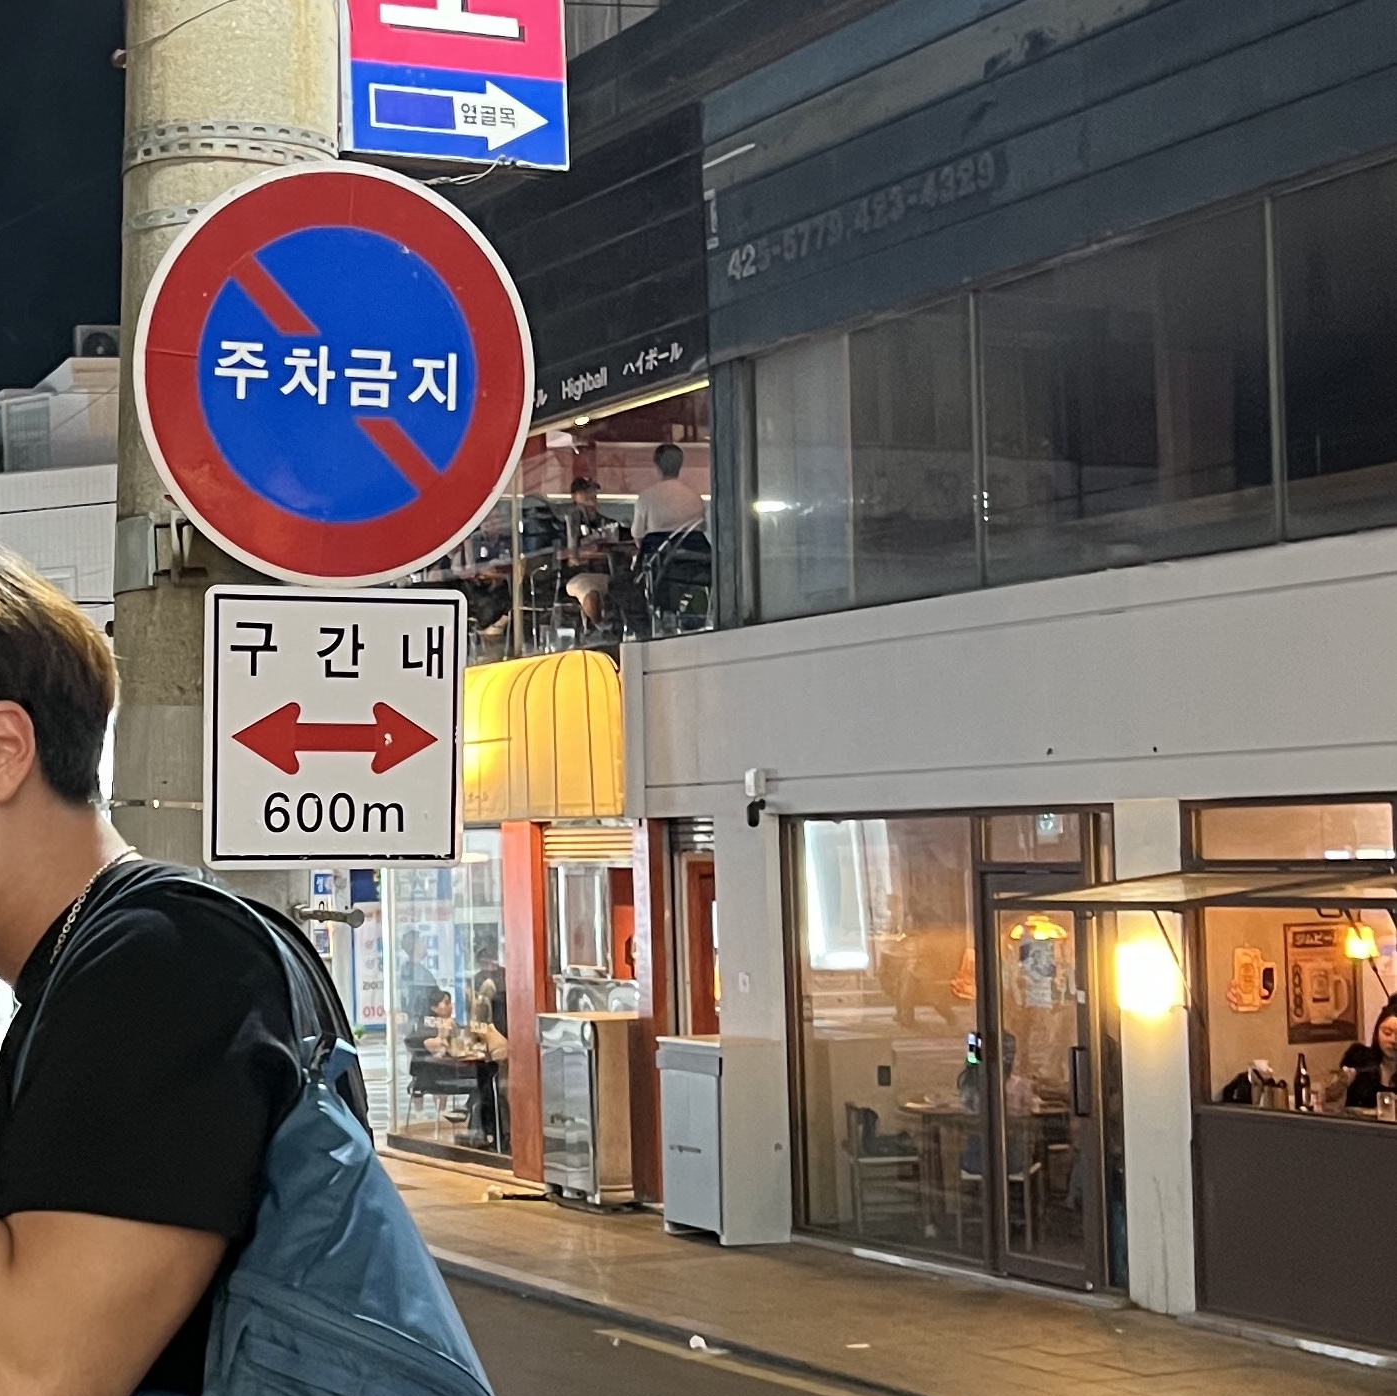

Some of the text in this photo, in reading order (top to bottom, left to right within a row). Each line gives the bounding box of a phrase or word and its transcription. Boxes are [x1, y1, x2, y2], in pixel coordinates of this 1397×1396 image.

[460, 102, 517, 129] 옆골목
[214, 340, 457, 411] 주차금지
[561, 366, 608, 400] Highball
[263, 792, 405, 833] 600m
